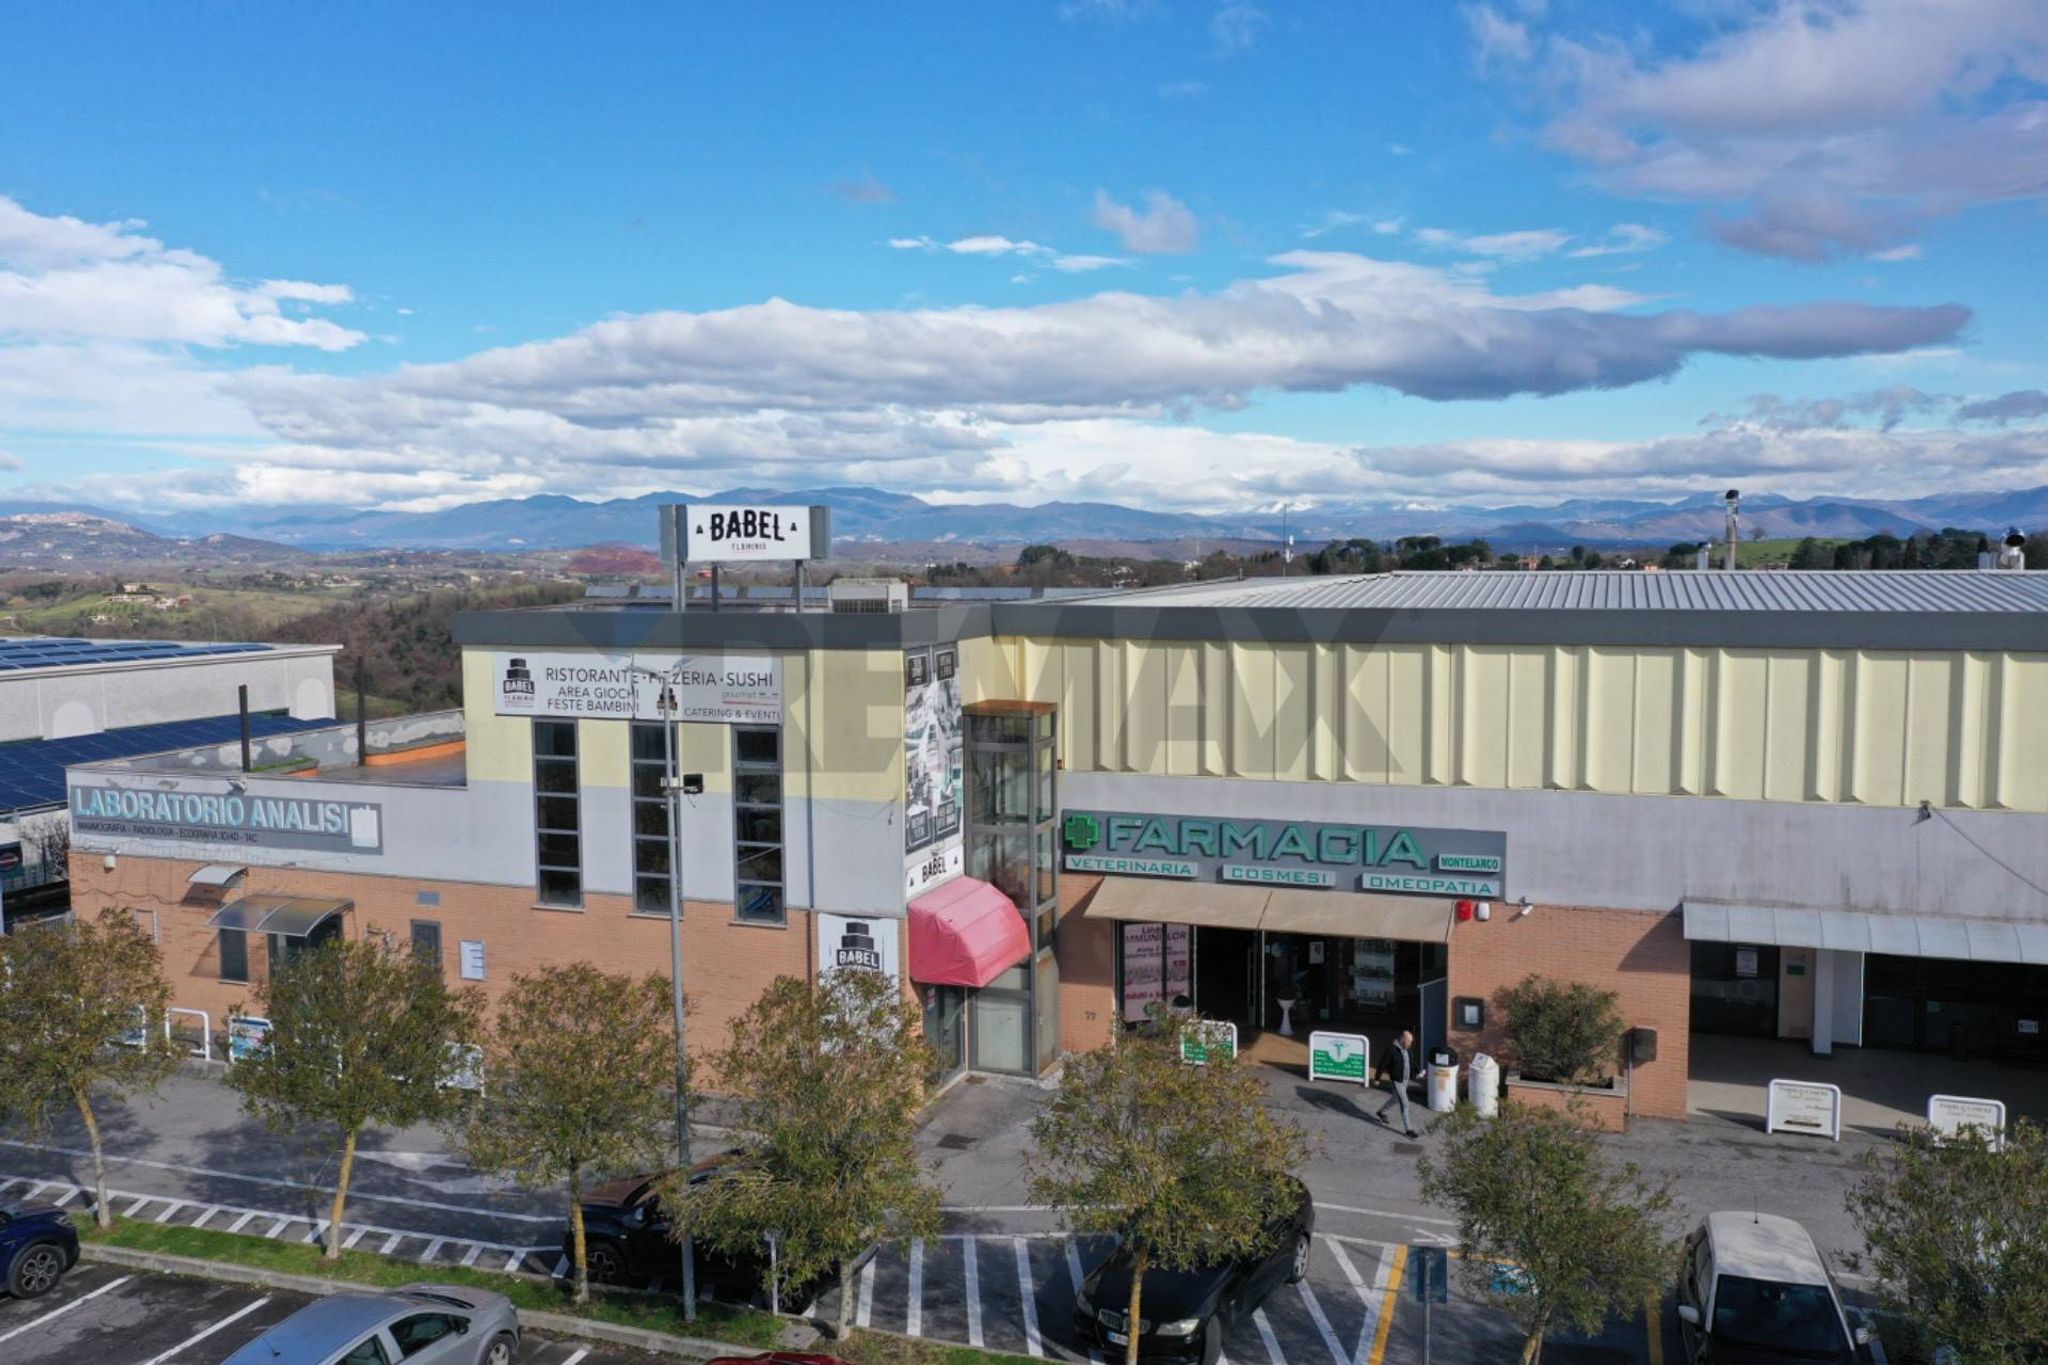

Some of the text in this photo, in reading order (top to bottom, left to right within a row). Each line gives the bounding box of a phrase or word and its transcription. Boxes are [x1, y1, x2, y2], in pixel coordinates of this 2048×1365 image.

[710, 509, 785, 541] BABEL
[503, 680, 535, 694] BABEL
[726, 672, 773, 688] SUSHI
[558, 687, 639, 700] AREA GIOCHI
[548, 700, 640, 712] FESTE BAMBINI
[684, 707, 732, 718] CATERING
[75, 787, 348, 834] LABORATORIO ANALISI
[1107, 816, 1428, 869] FARMACIA
[922, 857, 947, 882] BABEL
[1441, 857, 1498, 870] MONTELARCO
[1071, 858, 1493, 895] VETERINARIA COSMESI OMEOPATIA
[839, 950, 878, 967] BABEL
